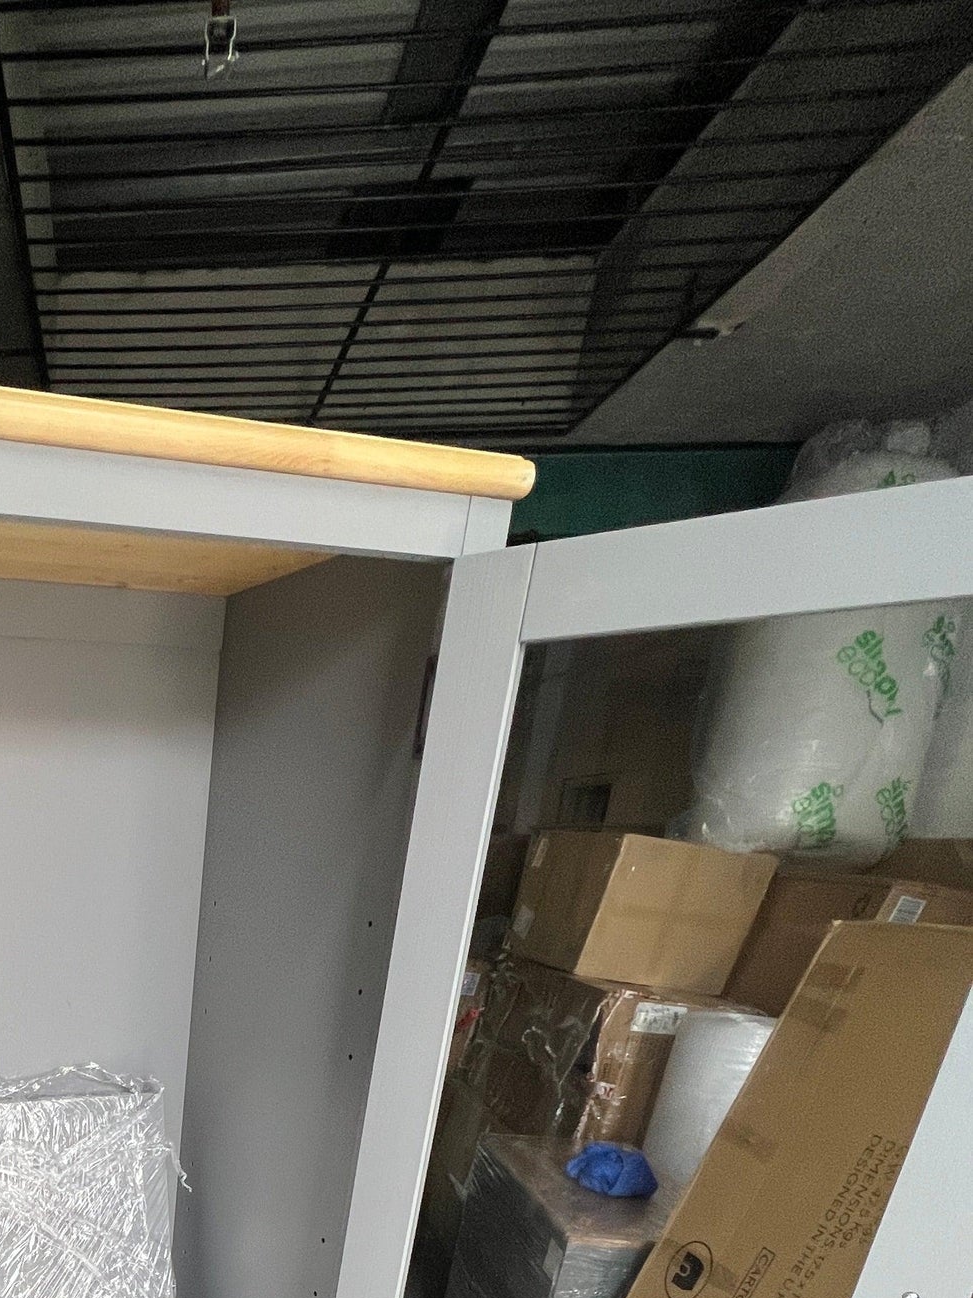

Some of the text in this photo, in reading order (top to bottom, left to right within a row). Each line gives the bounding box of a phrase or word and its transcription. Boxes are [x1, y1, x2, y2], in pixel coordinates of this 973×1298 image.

[824, 1134, 882, 1221] DESIGNED
[811, 1223, 827, 1242] IN
[790, 1243, 814, 1276] THE
